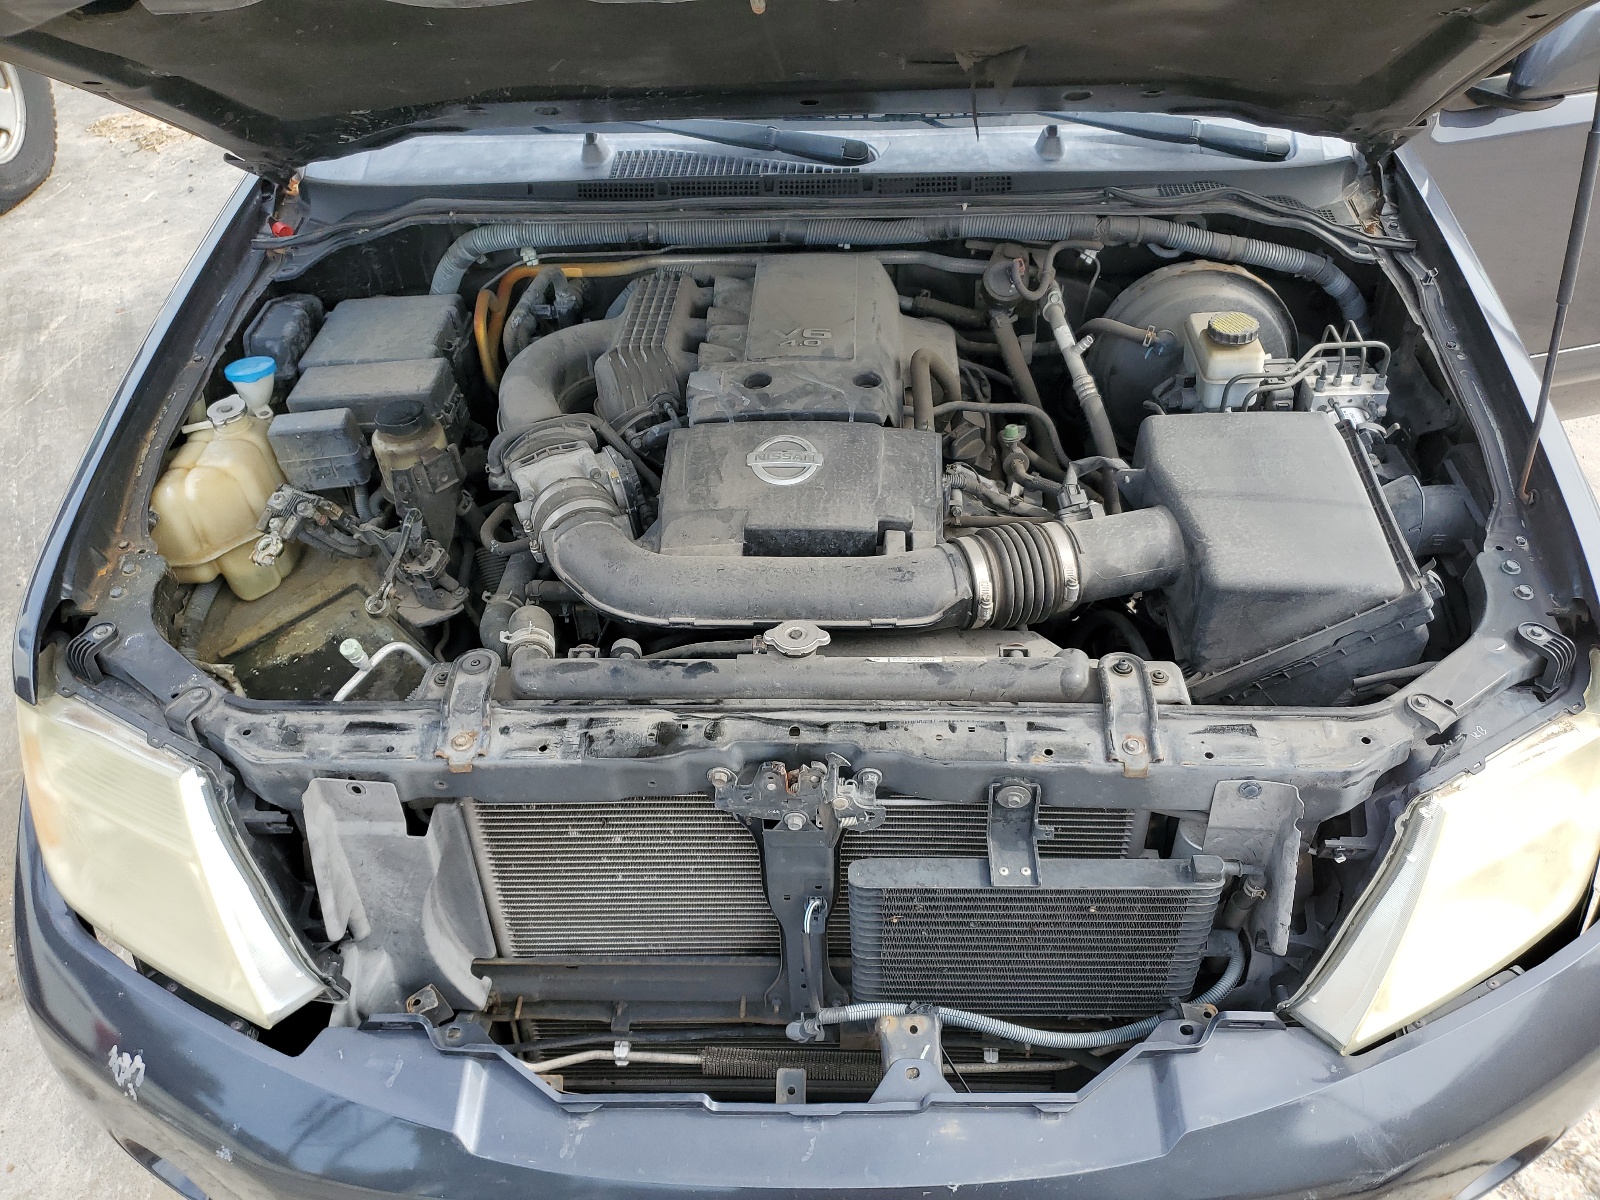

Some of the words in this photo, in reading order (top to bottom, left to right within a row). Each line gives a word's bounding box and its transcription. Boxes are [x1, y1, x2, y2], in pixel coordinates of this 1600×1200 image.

[769, 328, 832, 339] V6
[779, 339, 822, 347] 4.0
[754, 452, 816, 462] NISSAN
